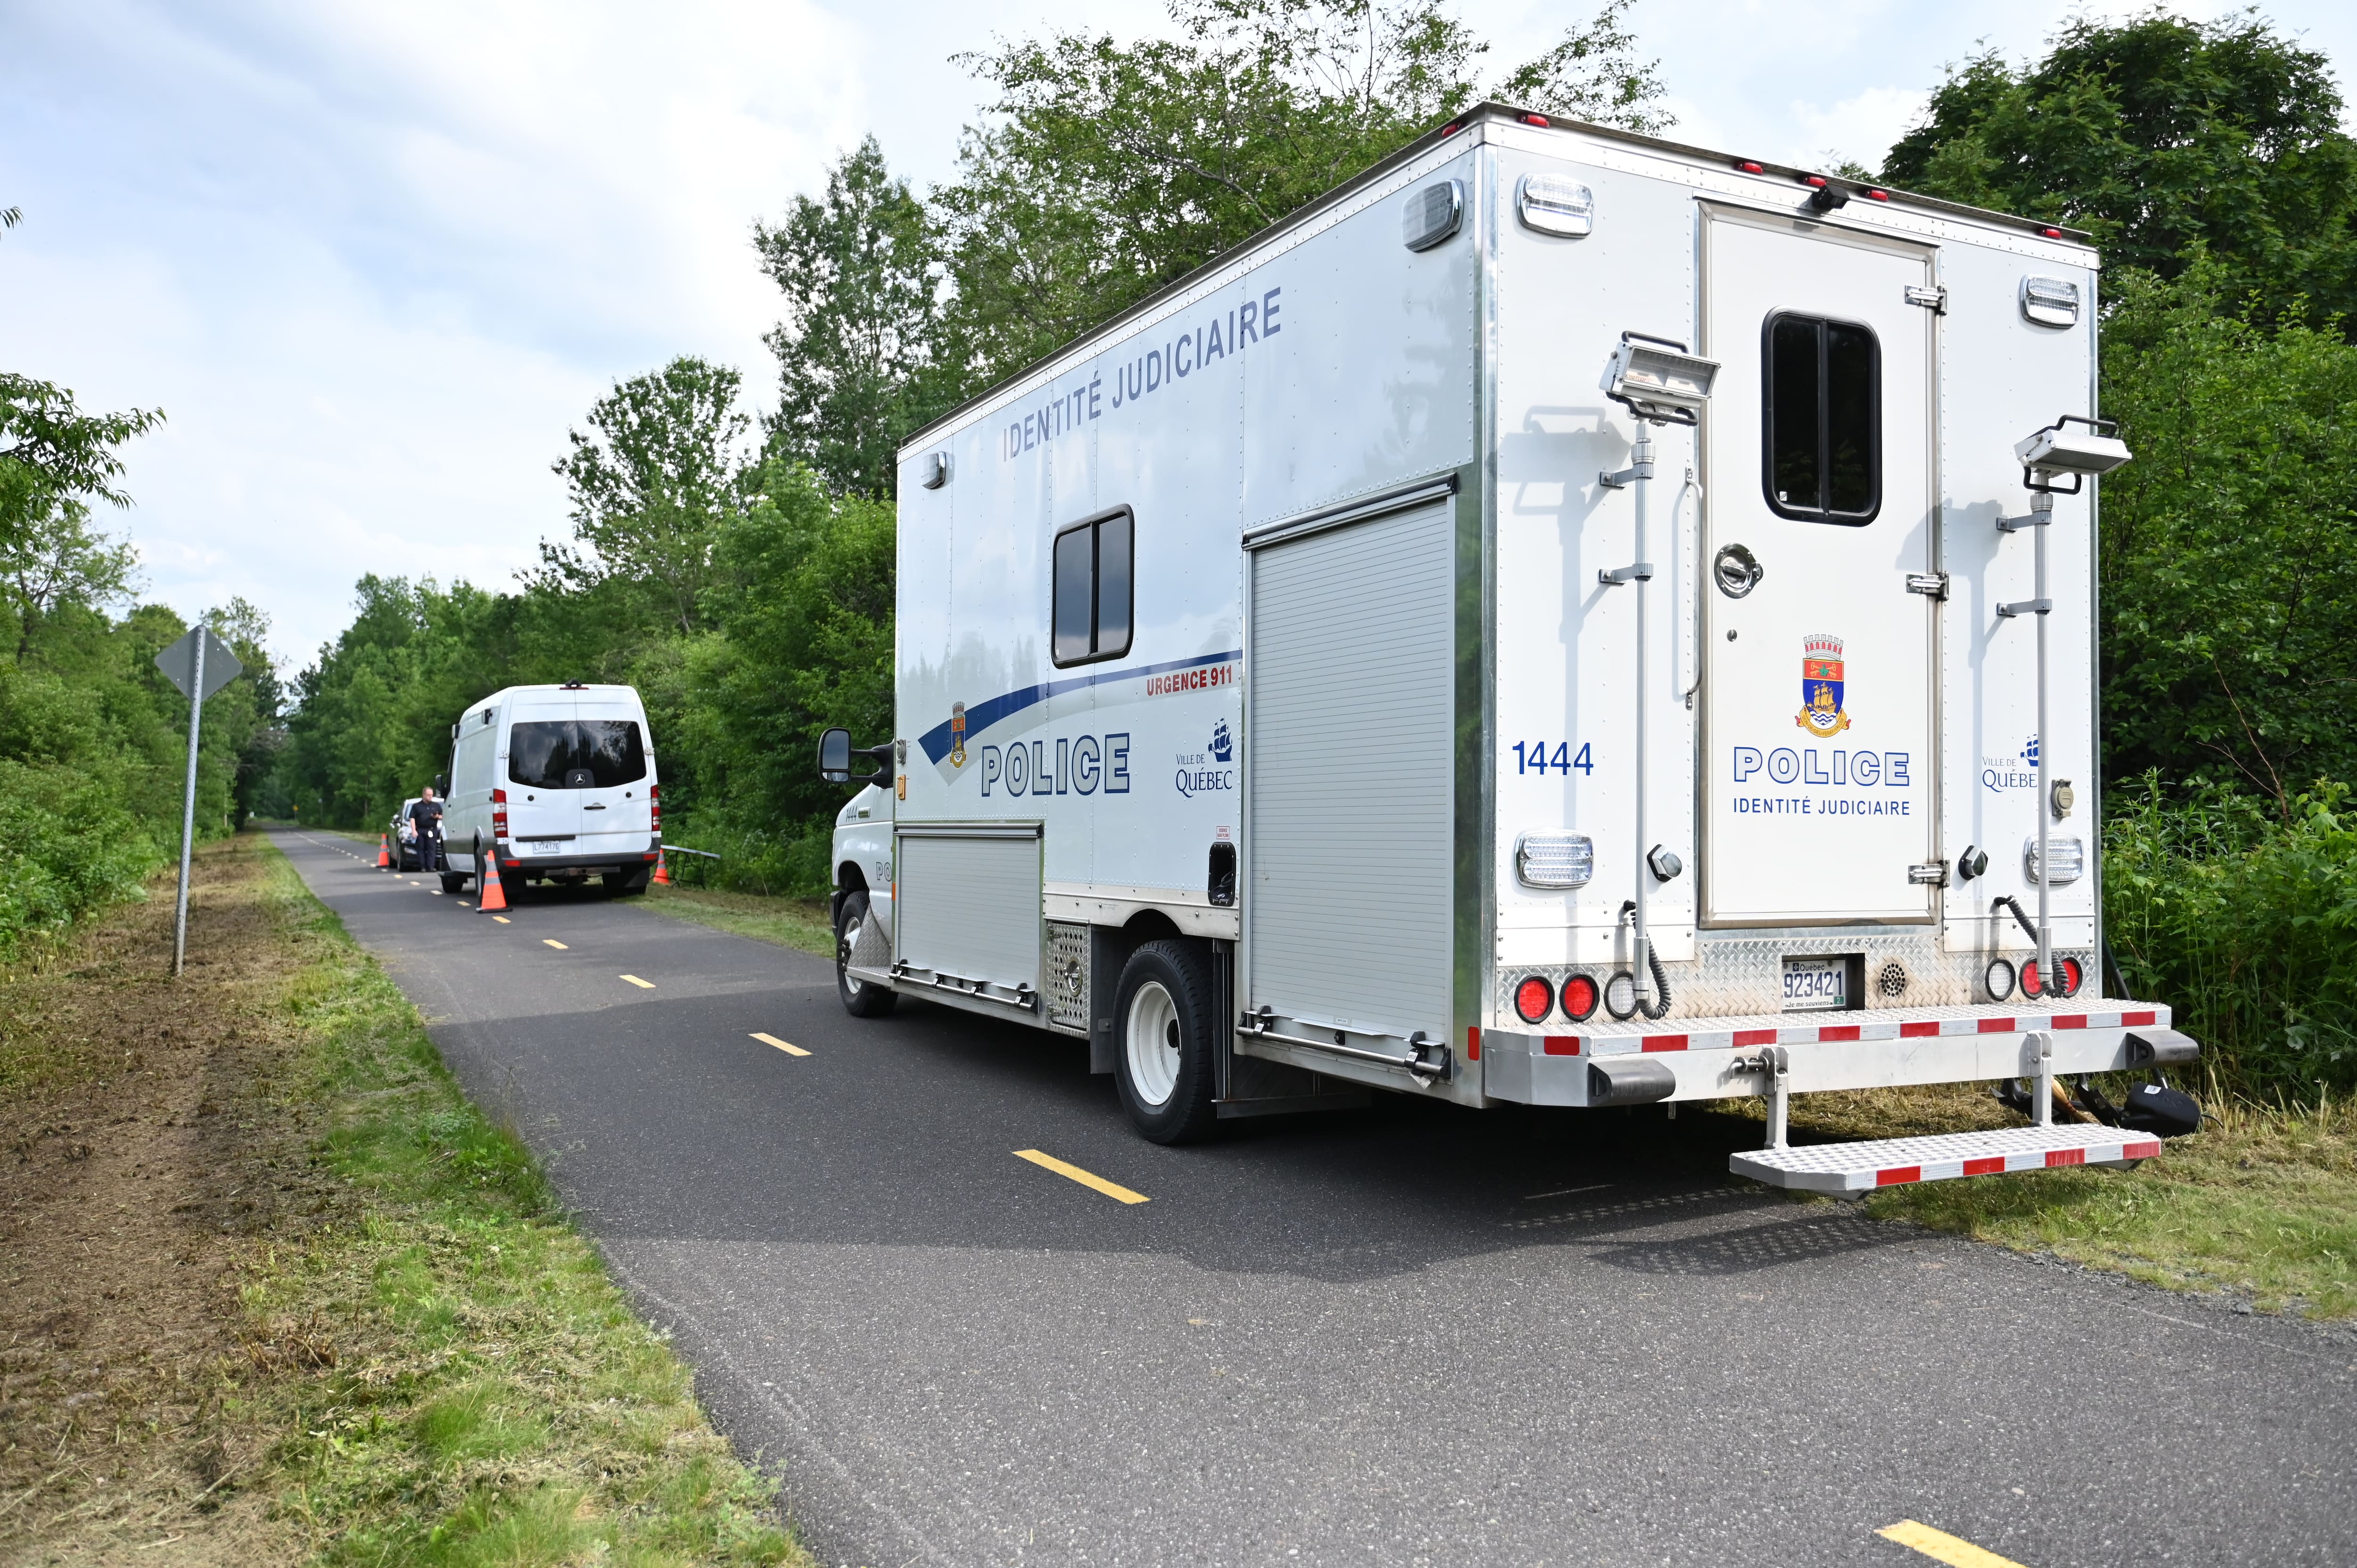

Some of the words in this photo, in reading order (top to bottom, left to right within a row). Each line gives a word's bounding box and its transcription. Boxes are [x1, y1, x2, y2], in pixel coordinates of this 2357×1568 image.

[1004, 370, 1101, 462] IDENTITÉ
[1113, 287, 1281, 409] JUDICIAIRE
[1147, 669, 1207, 696] URGENCE
[1211, 665, 1232, 686] 911
[981, 732, 1130, 797] POLICE
[1176, 754, 1195, 765] VILLE
[1196, 754, 1205, 763] DE
[1512, 740, 1594, 776] 1444
[1734, 747, 1910, 786] POLICE
[1982, 756, 2004, 766] VILLE
[1176, 767, 1232, 798] QUÉBEC
[1982, 769, 2038, 793] QUÉBE
[846, 805, 857, 822] 1444
[1733, 796, 1811, 814] IDENTITÉ
[1818, 799, 1910, 815] JUDICIAIRE
[1800, 963, 1825, 971] Québec
